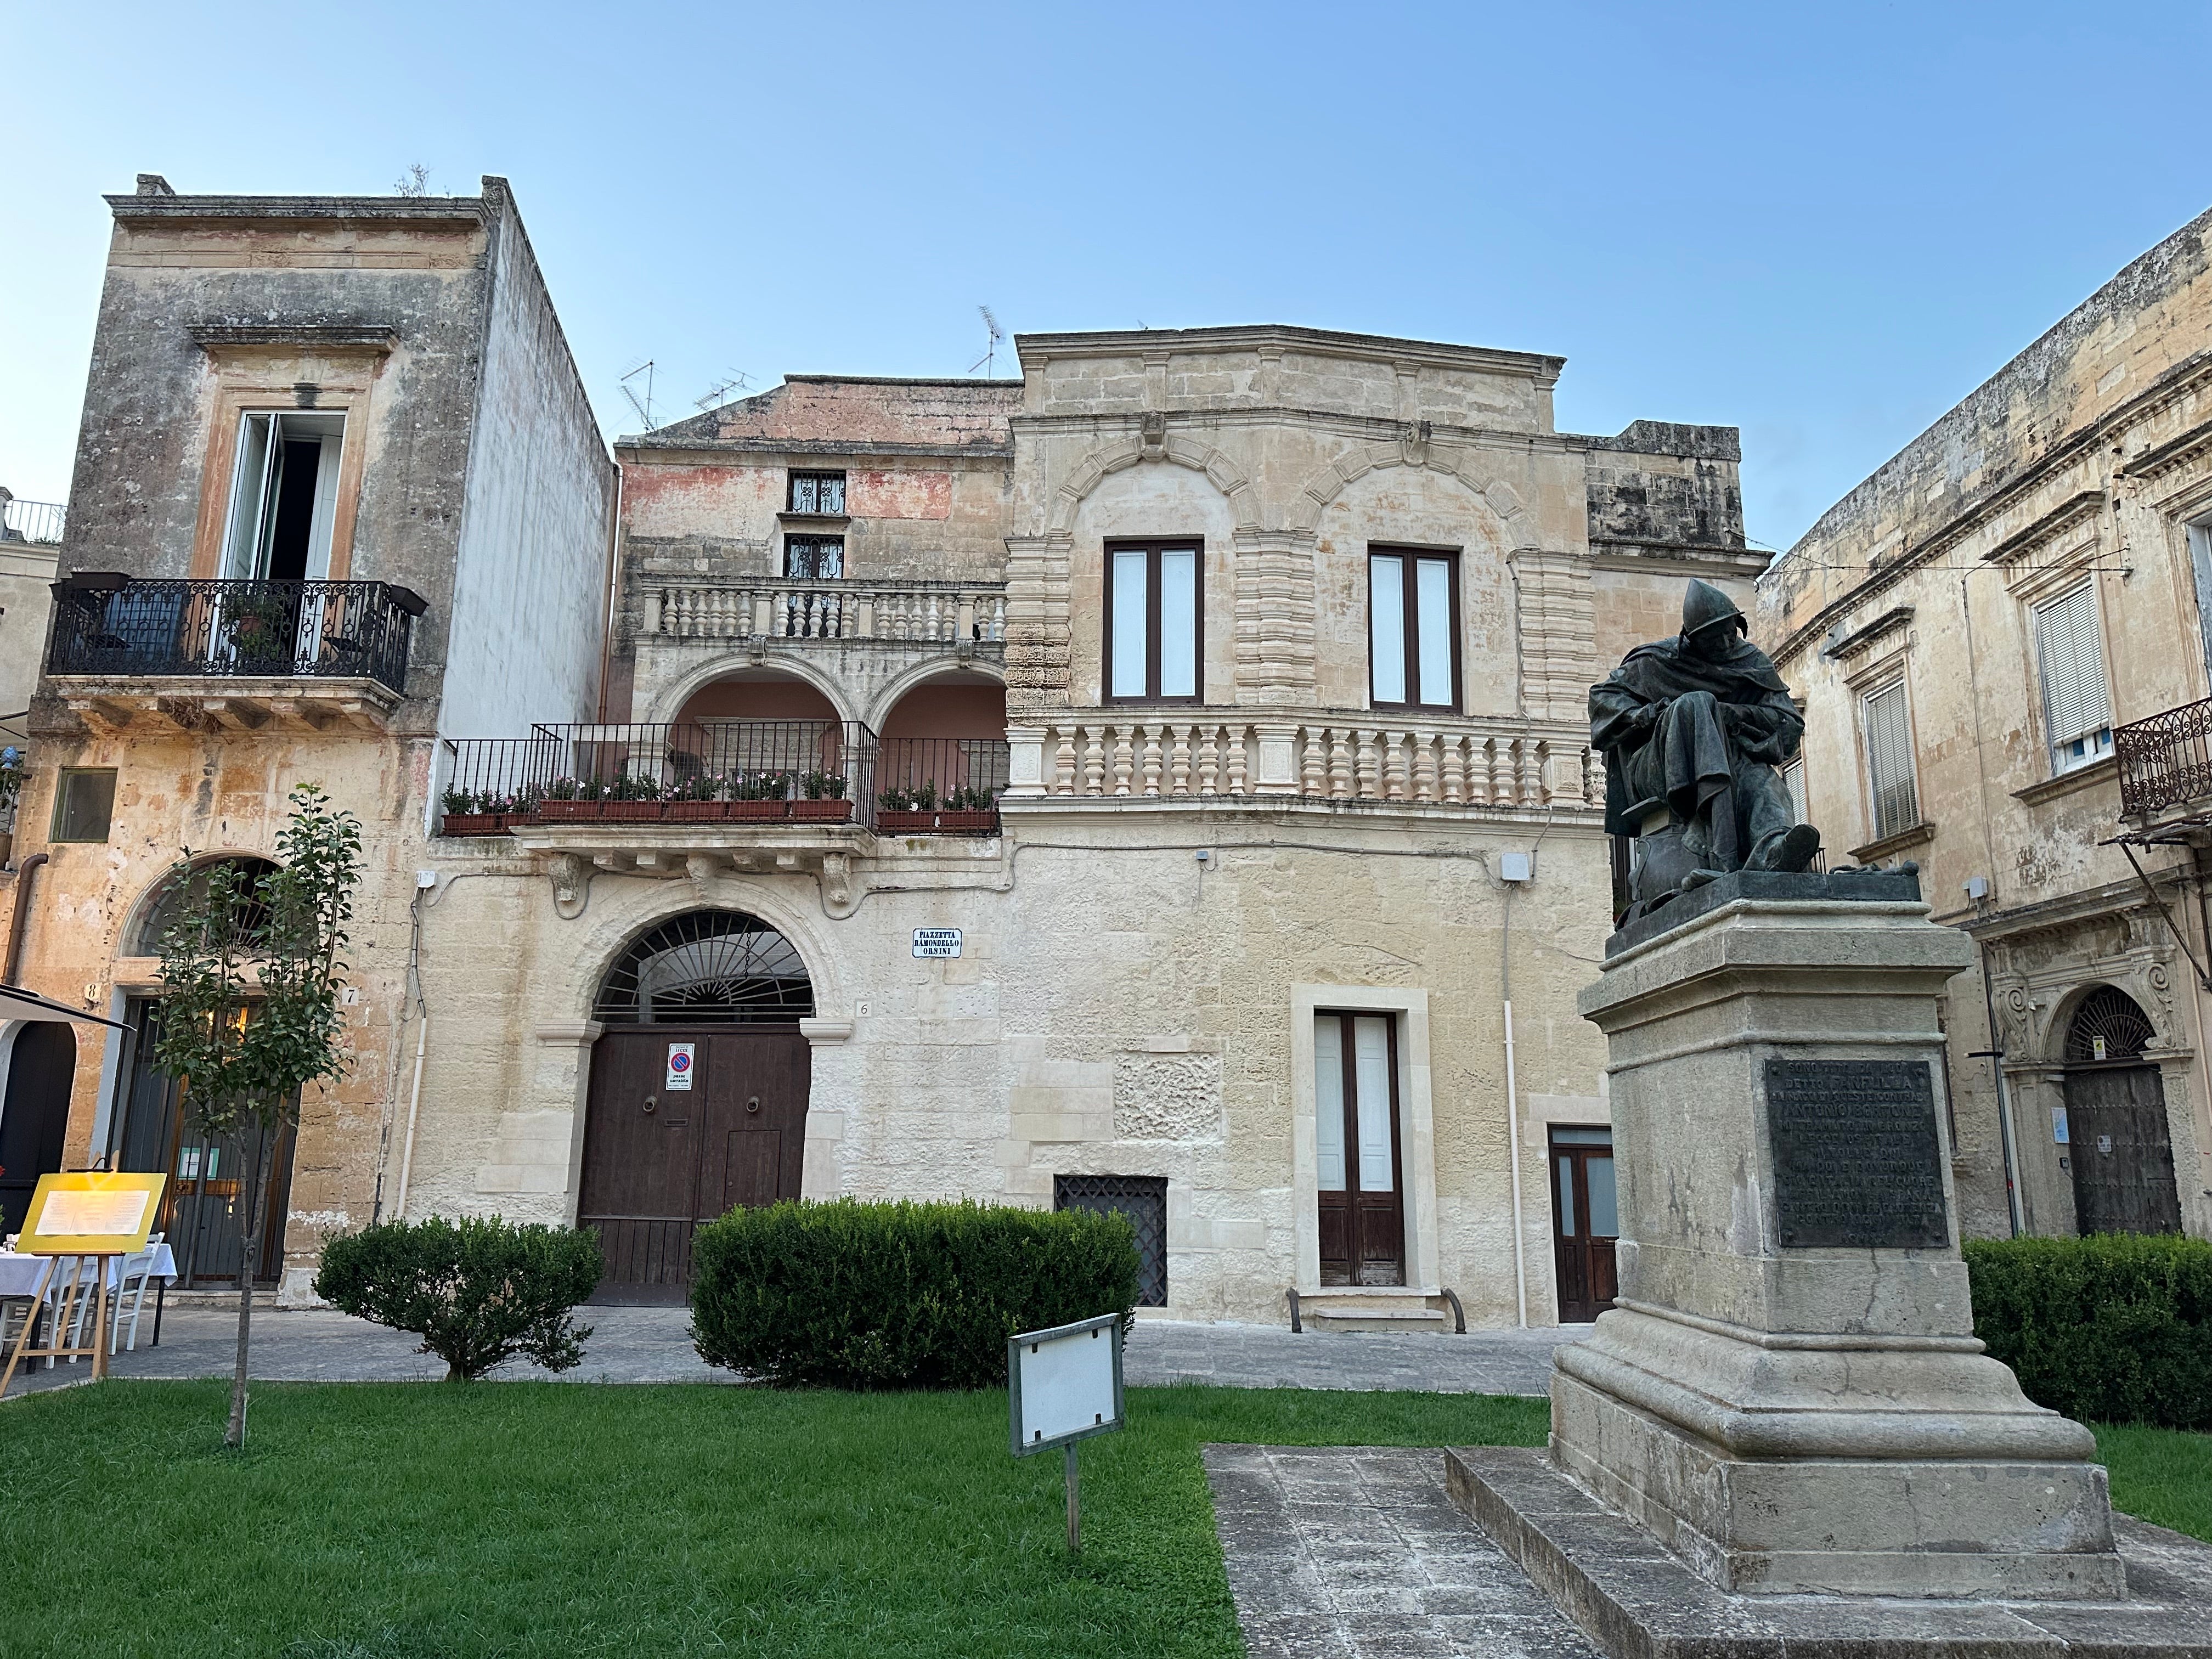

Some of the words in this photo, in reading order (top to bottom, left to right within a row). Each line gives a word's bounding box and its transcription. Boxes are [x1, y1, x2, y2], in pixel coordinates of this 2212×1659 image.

[88, 984, 96, 998] 8
[348, 989, 355, 1003] 7
[861, 1004, 867, 1014] 6
[1787, 1062, 1818, 1074] SONO
[1785, 1078, 1824, 1090] DETTO
[1831, 1076, 1912, 1090] FANFULLA
[1832, 1091, 1874, 1103] QUESTE
[1784, 1104, 1849, 1118] ANTONIO
[1854, 1104, 1921, 1118] BORTONE
[1878, 1121, 1926, 1132] BRONZO
[1799, 1133, 1838, 1144] LECCE
[1896, 1176, 1934, 1188] CUORE
